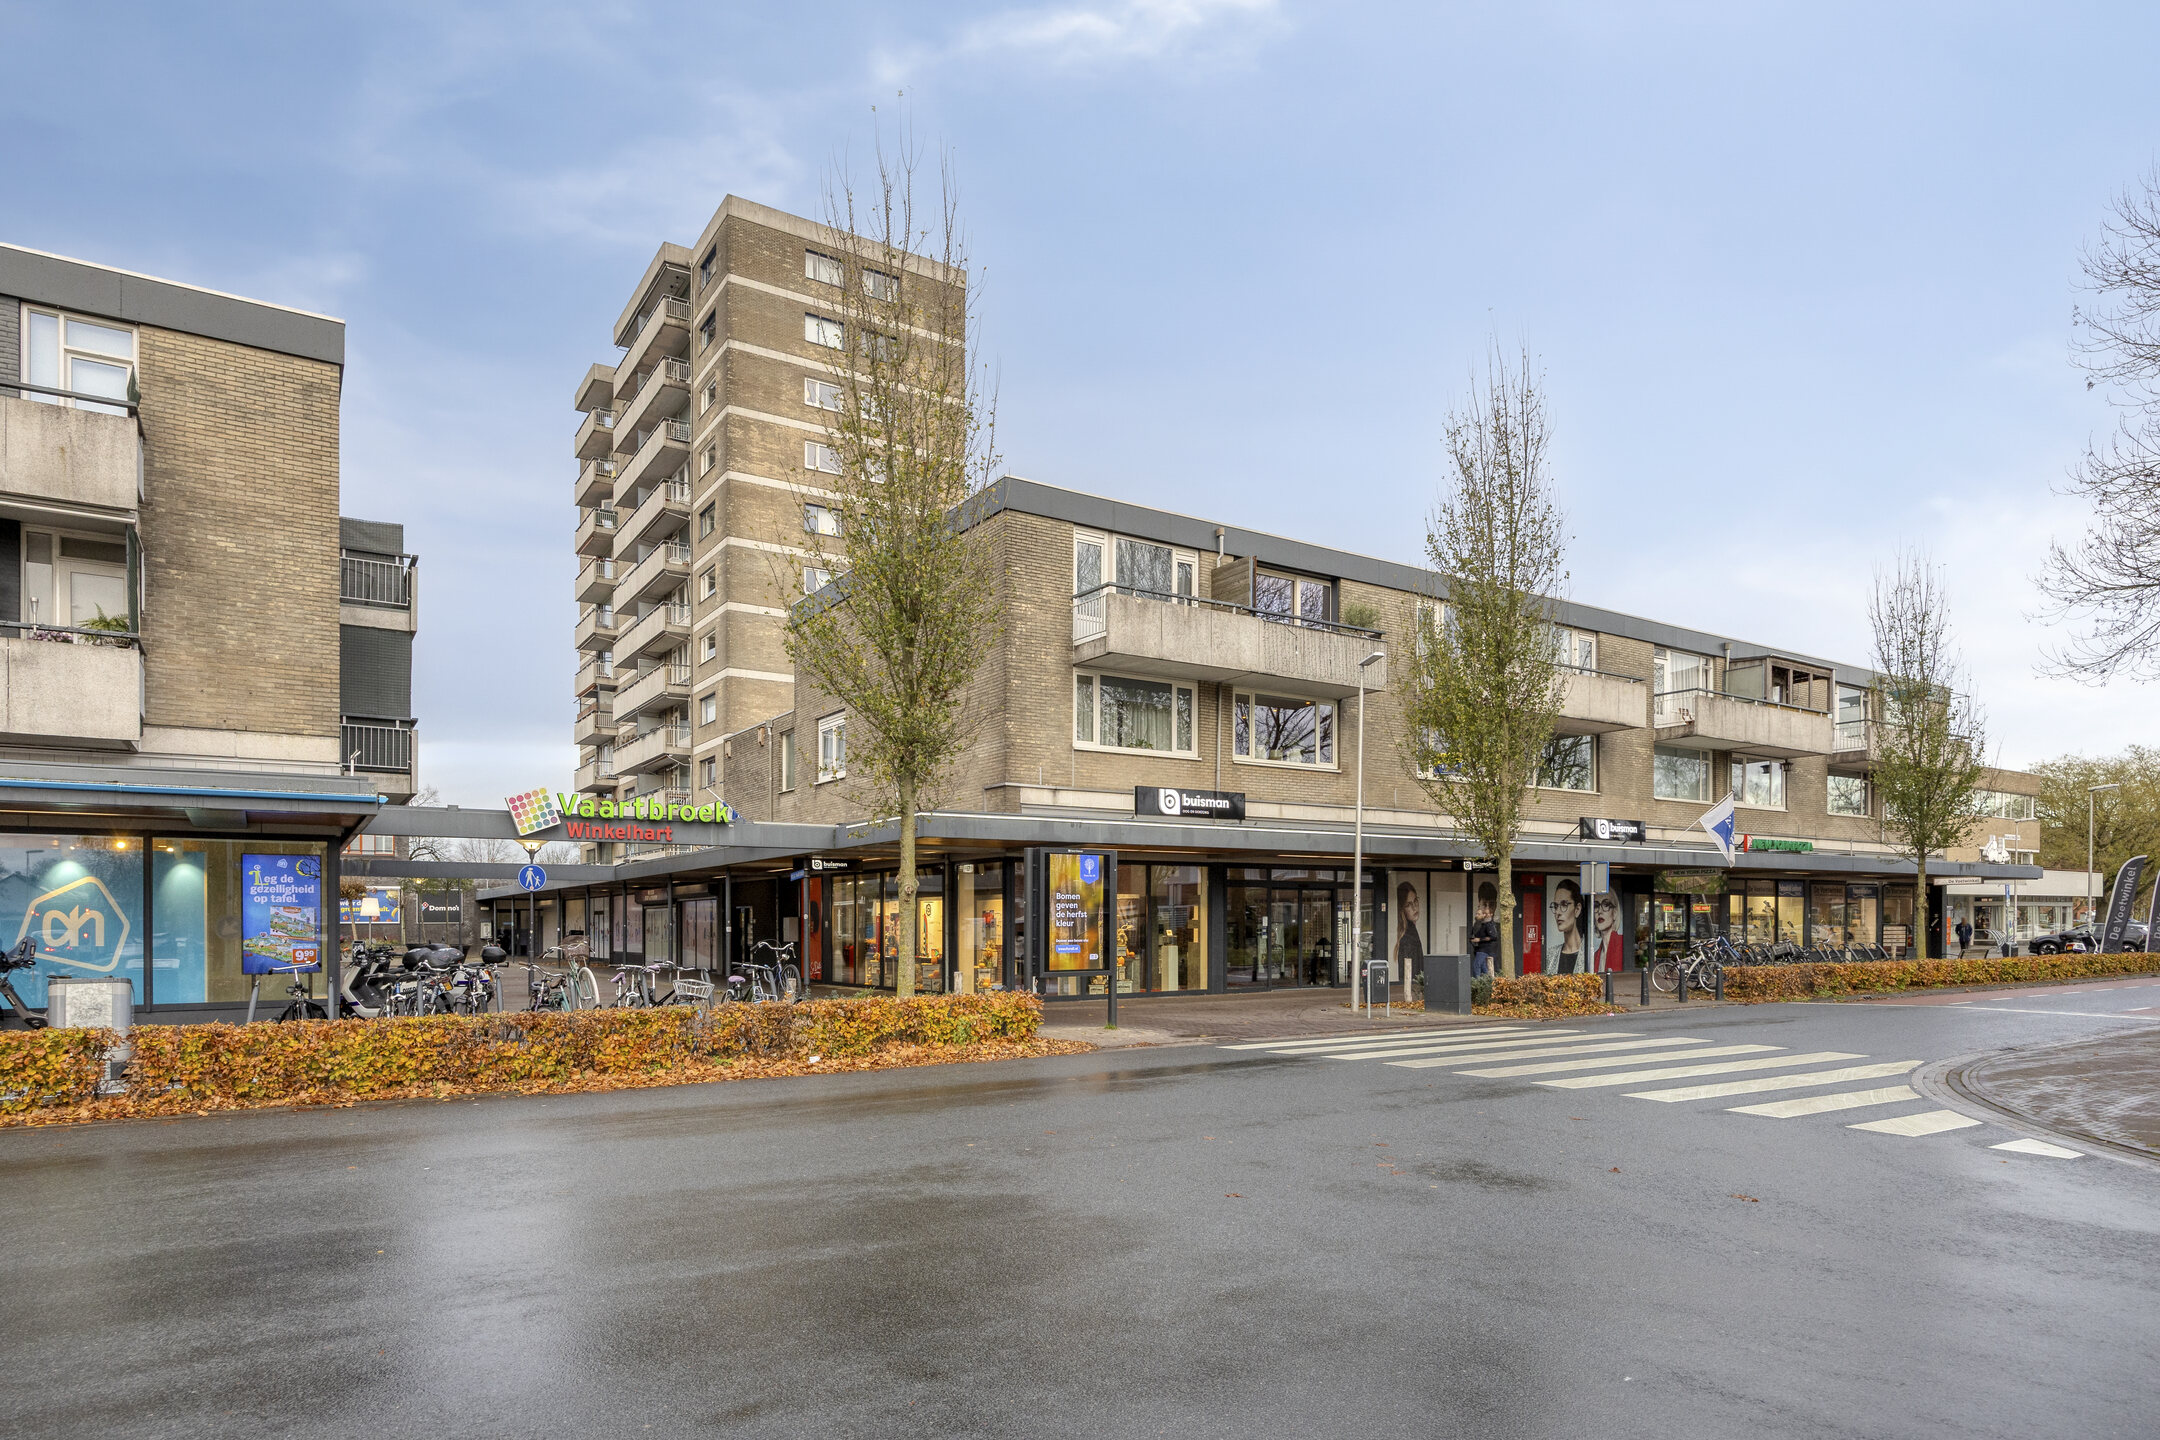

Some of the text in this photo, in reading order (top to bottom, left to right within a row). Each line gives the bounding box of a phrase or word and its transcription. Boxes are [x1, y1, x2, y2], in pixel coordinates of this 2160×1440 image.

[1181, 793, 1230, 809] buisman
[557, 792, 730, 823] Vaartbroek
[566, 821, 673, 841] Winkelhart
[1609, 822, 1638, 834] buisman
[249, 870, 294, 885] Leg de
[250, 885, 314, 895] gezelligheid
[1055, 892, 1081, 900] Bomen
[253, 893, 299, 904] op tafel.
[2108, 867, 2137, 940] De Voetwinkel
[1055, 902, 1079, 911] geven
[1066, 910, 1088, 918] herfst
